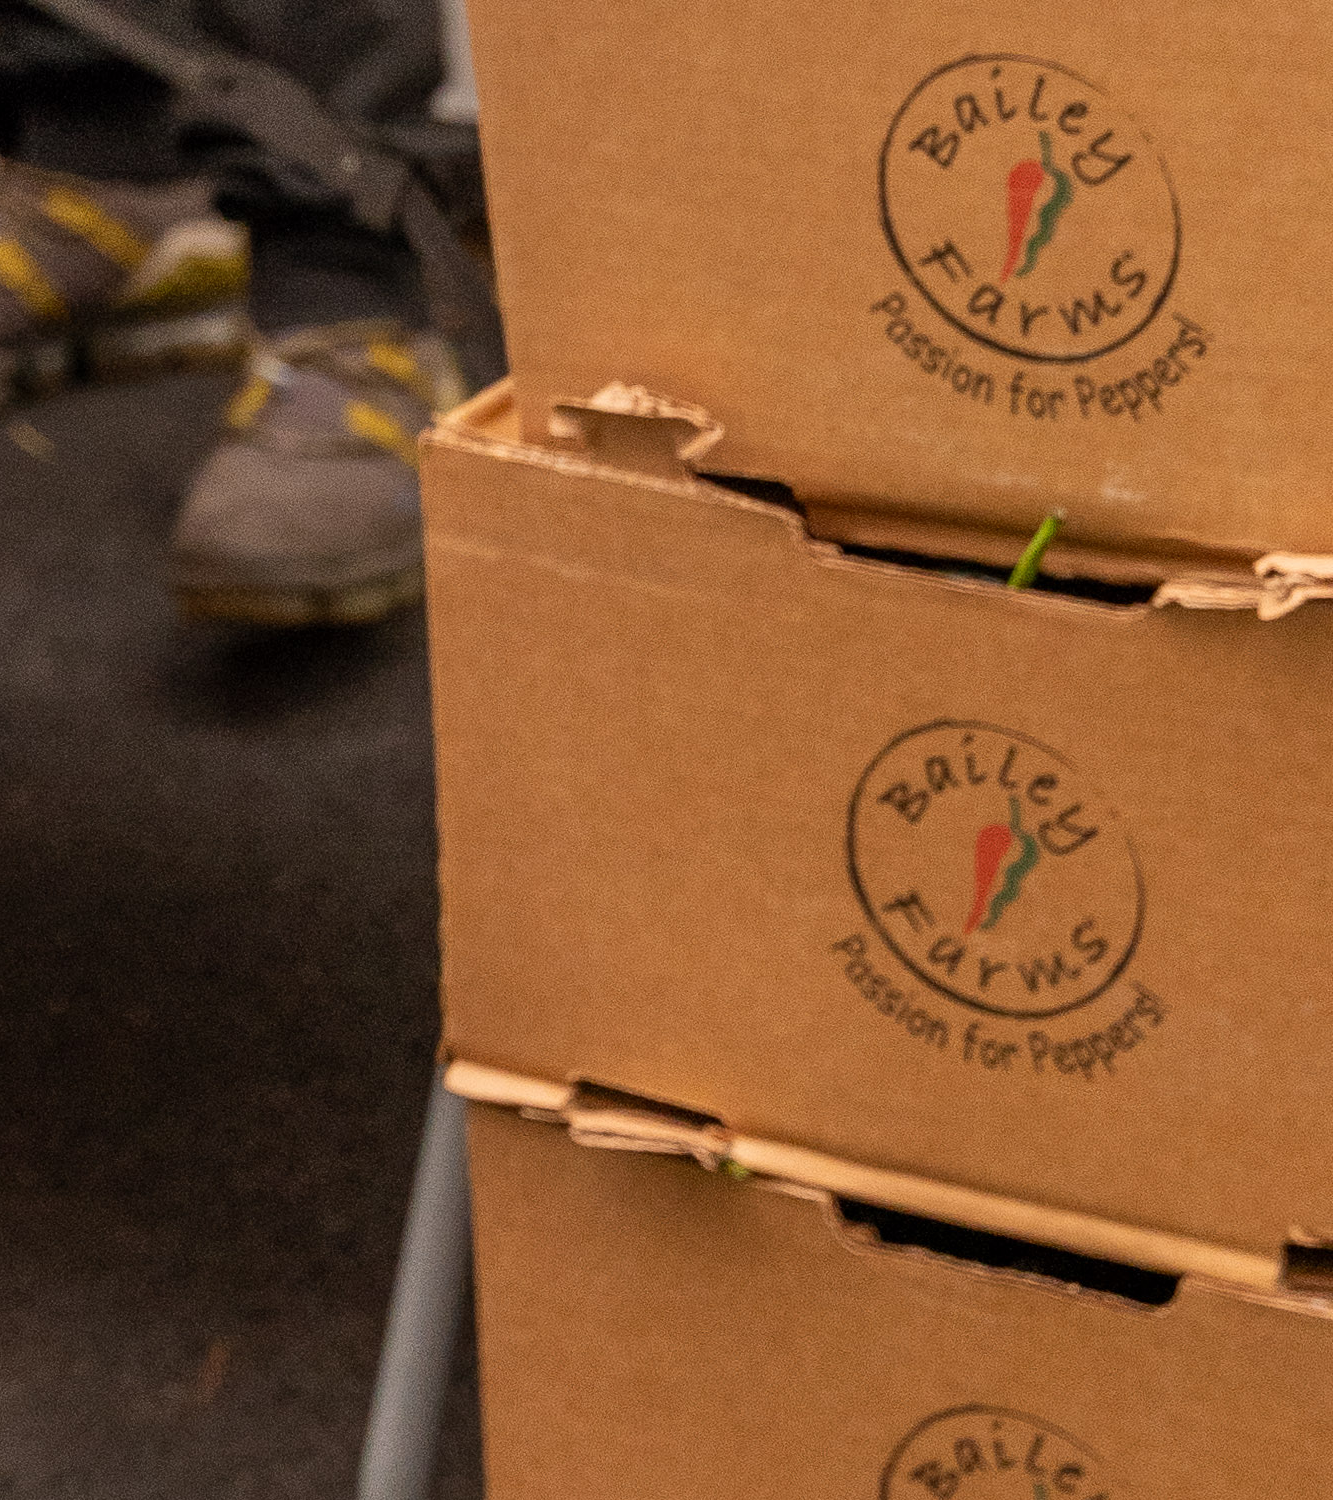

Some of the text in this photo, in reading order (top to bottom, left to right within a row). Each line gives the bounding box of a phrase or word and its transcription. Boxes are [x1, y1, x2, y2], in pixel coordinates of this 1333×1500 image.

[908, 66, 1133, 188] Bailey
[916, 238, 1147, 337] Farms
[870, 290, 996, 406] Passion
[1009, 369, 1066, 420] for
[878, 733, 1100, 857] Bailey
[883, 890, 1109, 993] Farms
